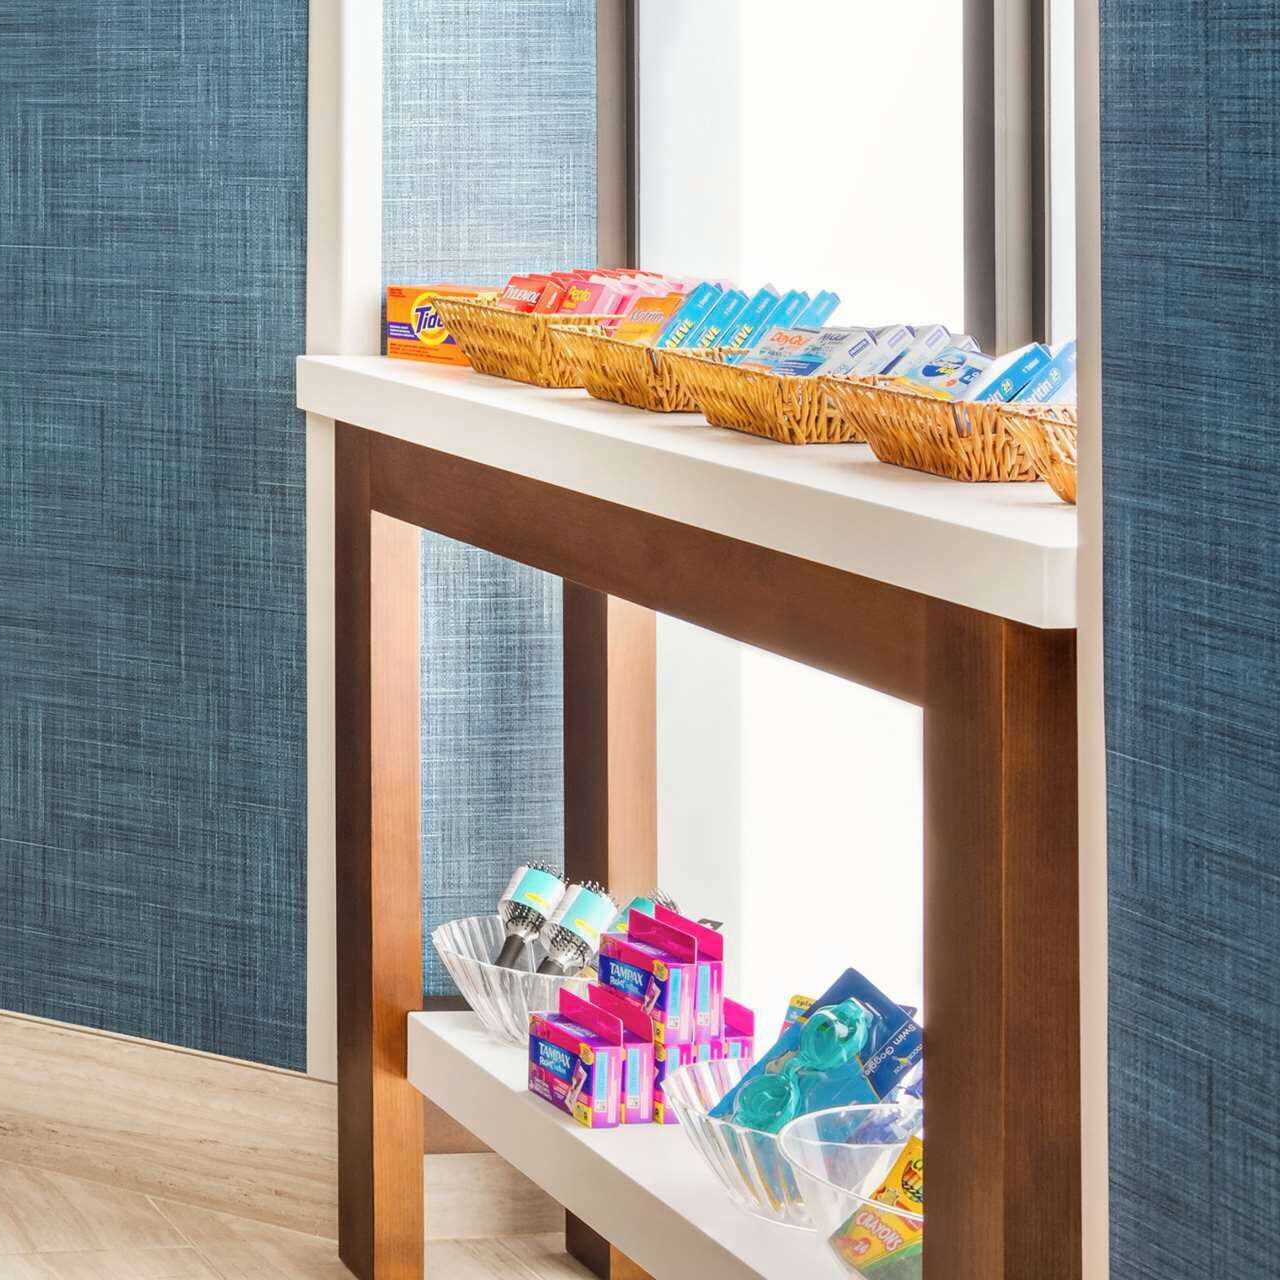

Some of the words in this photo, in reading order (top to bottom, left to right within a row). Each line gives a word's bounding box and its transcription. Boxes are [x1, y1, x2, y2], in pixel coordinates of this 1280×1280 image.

[608, 961, 645, 987] TAMPAX
[892, 1023, 917, 1046] Swim
[538, 1041, 572, 1069] TAMPAX
